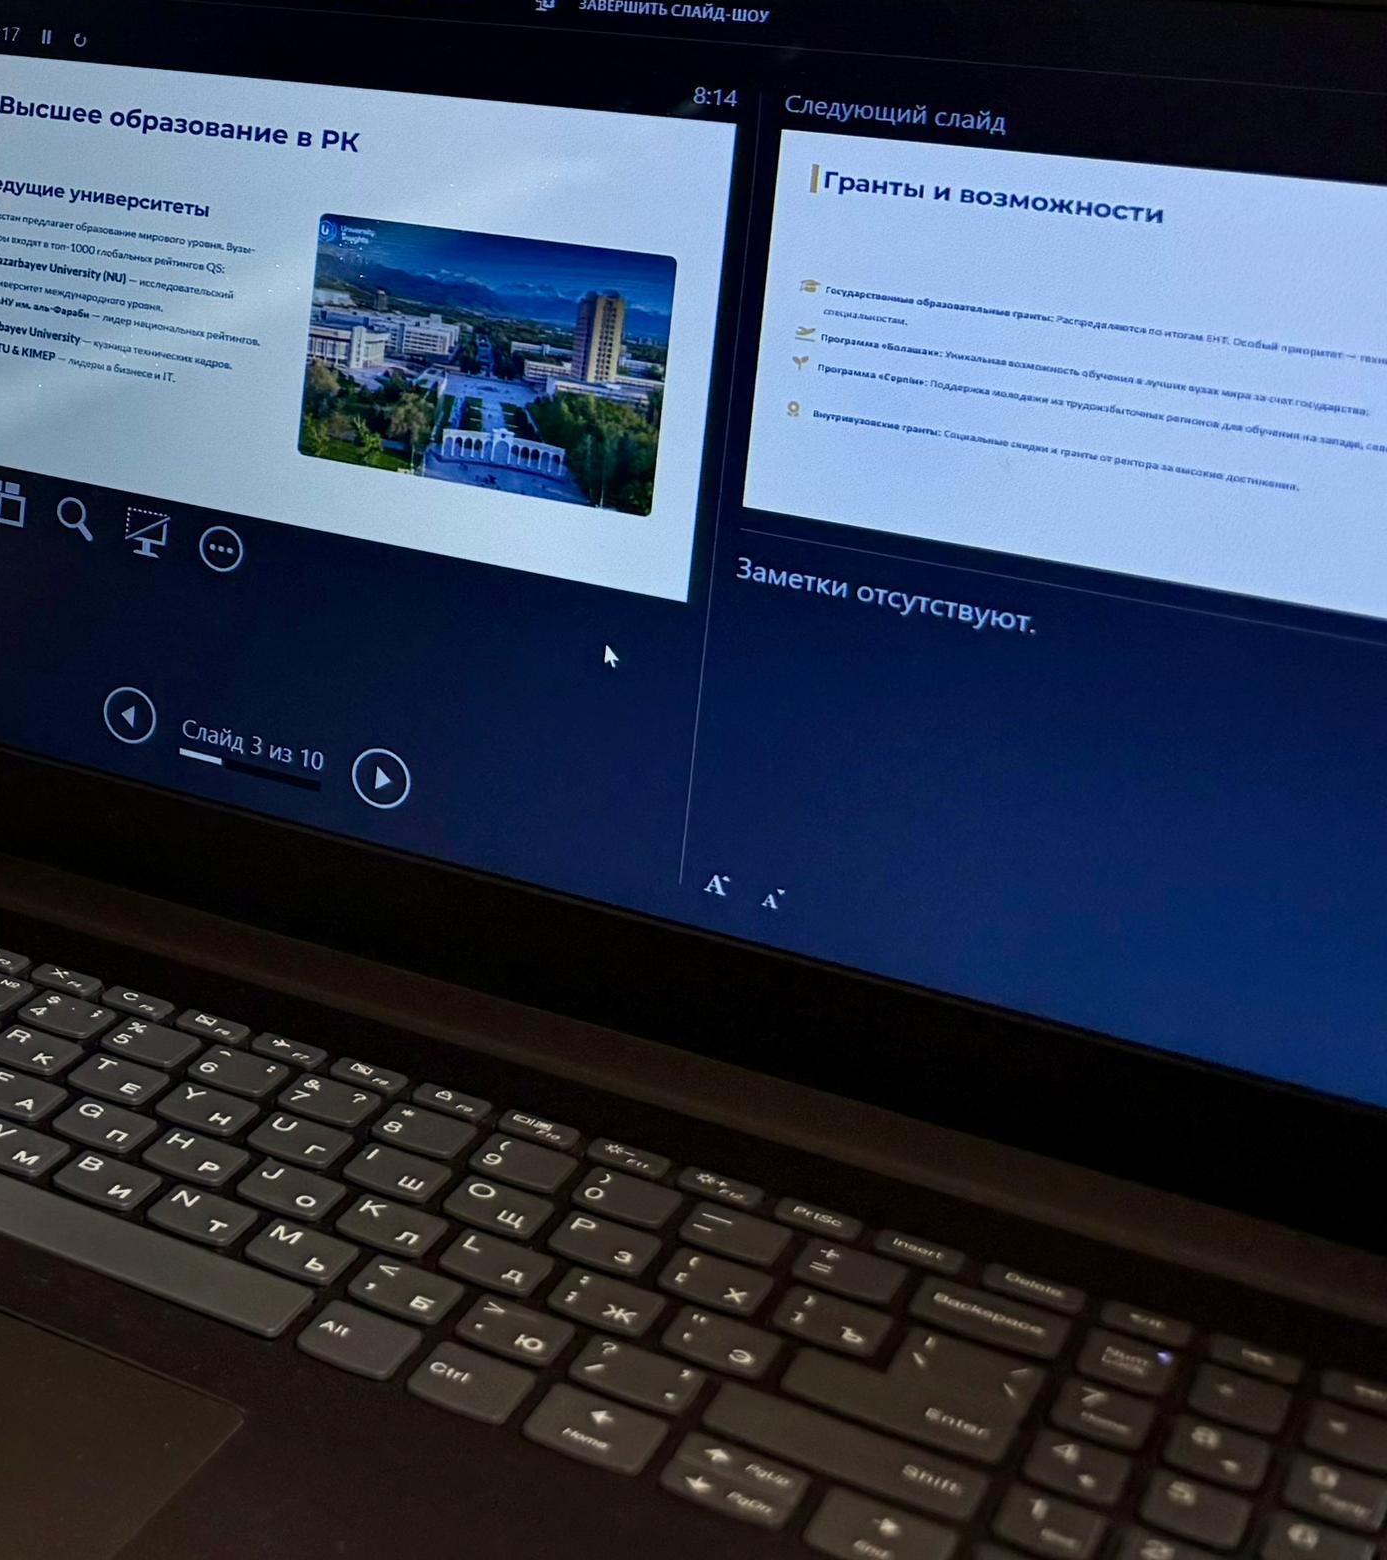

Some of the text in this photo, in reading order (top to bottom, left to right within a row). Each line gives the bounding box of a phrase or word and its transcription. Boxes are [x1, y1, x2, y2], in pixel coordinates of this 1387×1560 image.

[671, 4, 770, 23] СЛАЙД-ШОУ
[693, 87, 738, 108] 8:14
[0, 96, 361, 154] Высшее образование в РК
[784, 94, 1006, 135] Следующий слайд
[69, 186, 209, 218] университеты
[824, 170, 1164, 225] Гранты и возможности
[23, 216, 74, 231] предлагает
[76, 222, 136, 238] образование
[139, 231, 185, 245] мирового
[187, 239, 225, 250] уровня.
[227, 242, 255, 254] Вузы-
[11, 236, 41, 248] входят
[51, 242, 95, 255] топ-1000
[97, 248, 152, 264] глобальных
[155, 256, 205, 270] рейтингов
[206, 262, 225, 274] QS:
[49, 262, 101, 281] University
[103, 271, 126, 284] (NU)
[139, 279, 234, 300] исследовательский
[45, 287, 125, 306] международного
[127, 300, 163, 313] уровня.
[33, 303, 89, 319] аль-Фараби
[103, 314, 131, 326] лидер
[133, 320, 205, 338] национальных
[207, 330, 260, 347] рейтингов.
[29, 327, 81, 346] University
[93, 340, 131, 353] кузница
[133, 346, 193, 363] технических
[195, 356, 233, 370] кадров.
[821, 334, 879, 350] Программа
[11, 344, 19, 356] &
[21, 347, 56, 361] KIMEP
[68, 356, 104, 371] лидеры
[113, 364, 153, 380] бизнесе
[163, 371, 176, 382] IT.
[818, 364, 876, 380] Программа
[736, 557, 1036, 635] Заметки отсутствуют.
[182, 718, 323, 771] Слайд 3 из 10
[792, 1205, 842, 1228] PrtSc
[892, 1238, 944, 1261] Insert
[1005, 1272, 1064, 1298] Delete
[320, 1320, 349, 1336] Alt
[934, 1292, 1046, 1336] Backspace
[430, 1361, 471, 1383] Ctrl
[563, 1427, 610, 1450] Home
[926, 1408, 990, 1437] Enter
[745, 1463, 794, 1488] PgUp
[902, 1464, 963, 1496] Shift
